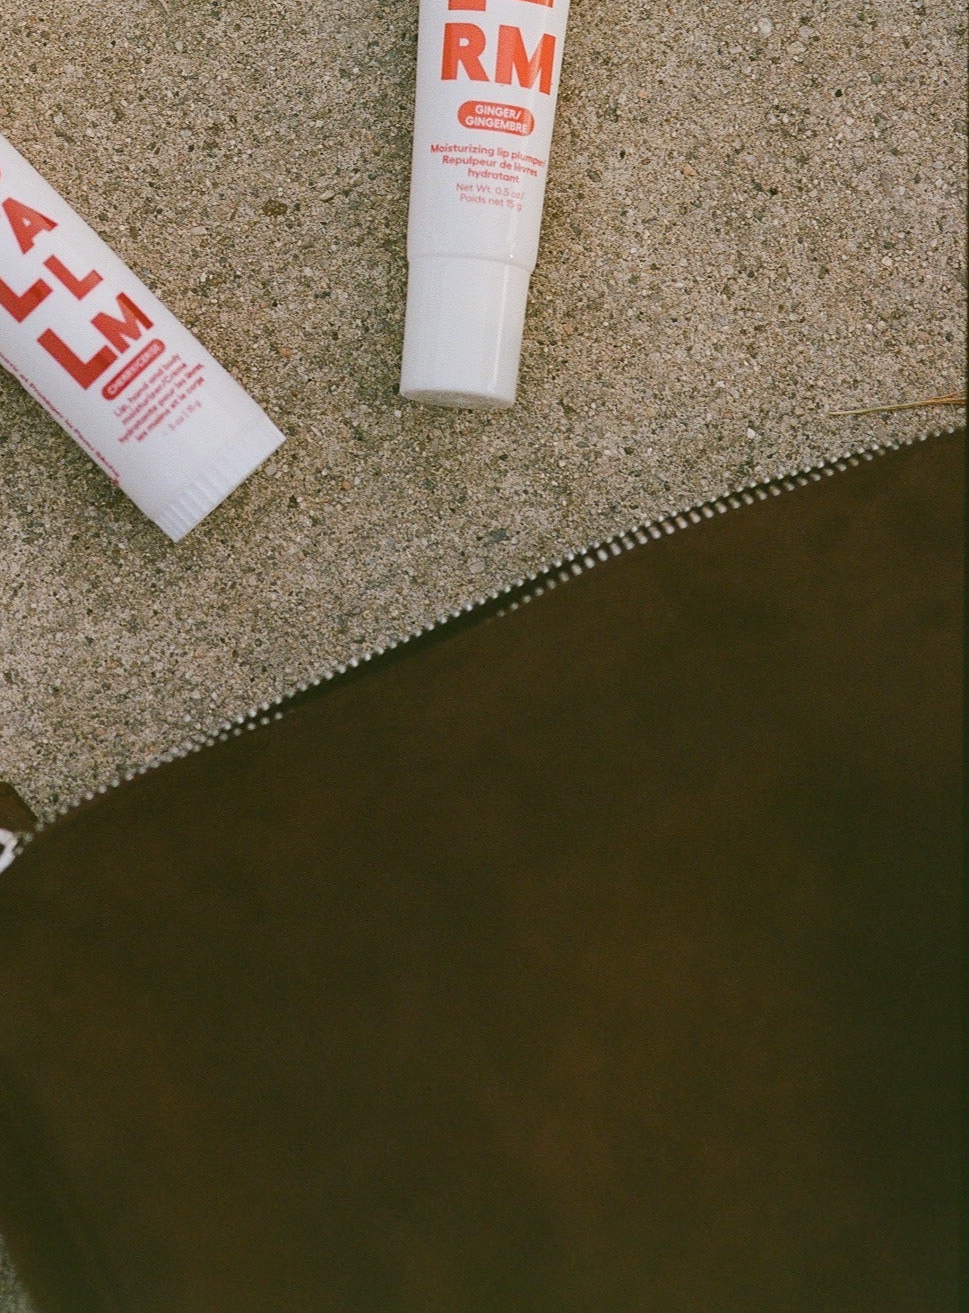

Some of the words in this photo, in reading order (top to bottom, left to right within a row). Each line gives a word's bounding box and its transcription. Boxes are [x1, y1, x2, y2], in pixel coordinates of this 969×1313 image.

[475, 104, 521, 119] GINGER/
[465, 115, 527, 133] GINGEMBRE
[431, 143, 494, 156] Moisturizing
[496, 147, 509, 159] lip
[443, 155, 496, 167] Repulpeur
[499, 160, 512, 170] de
[467, 167, 520, 182] hydratant
